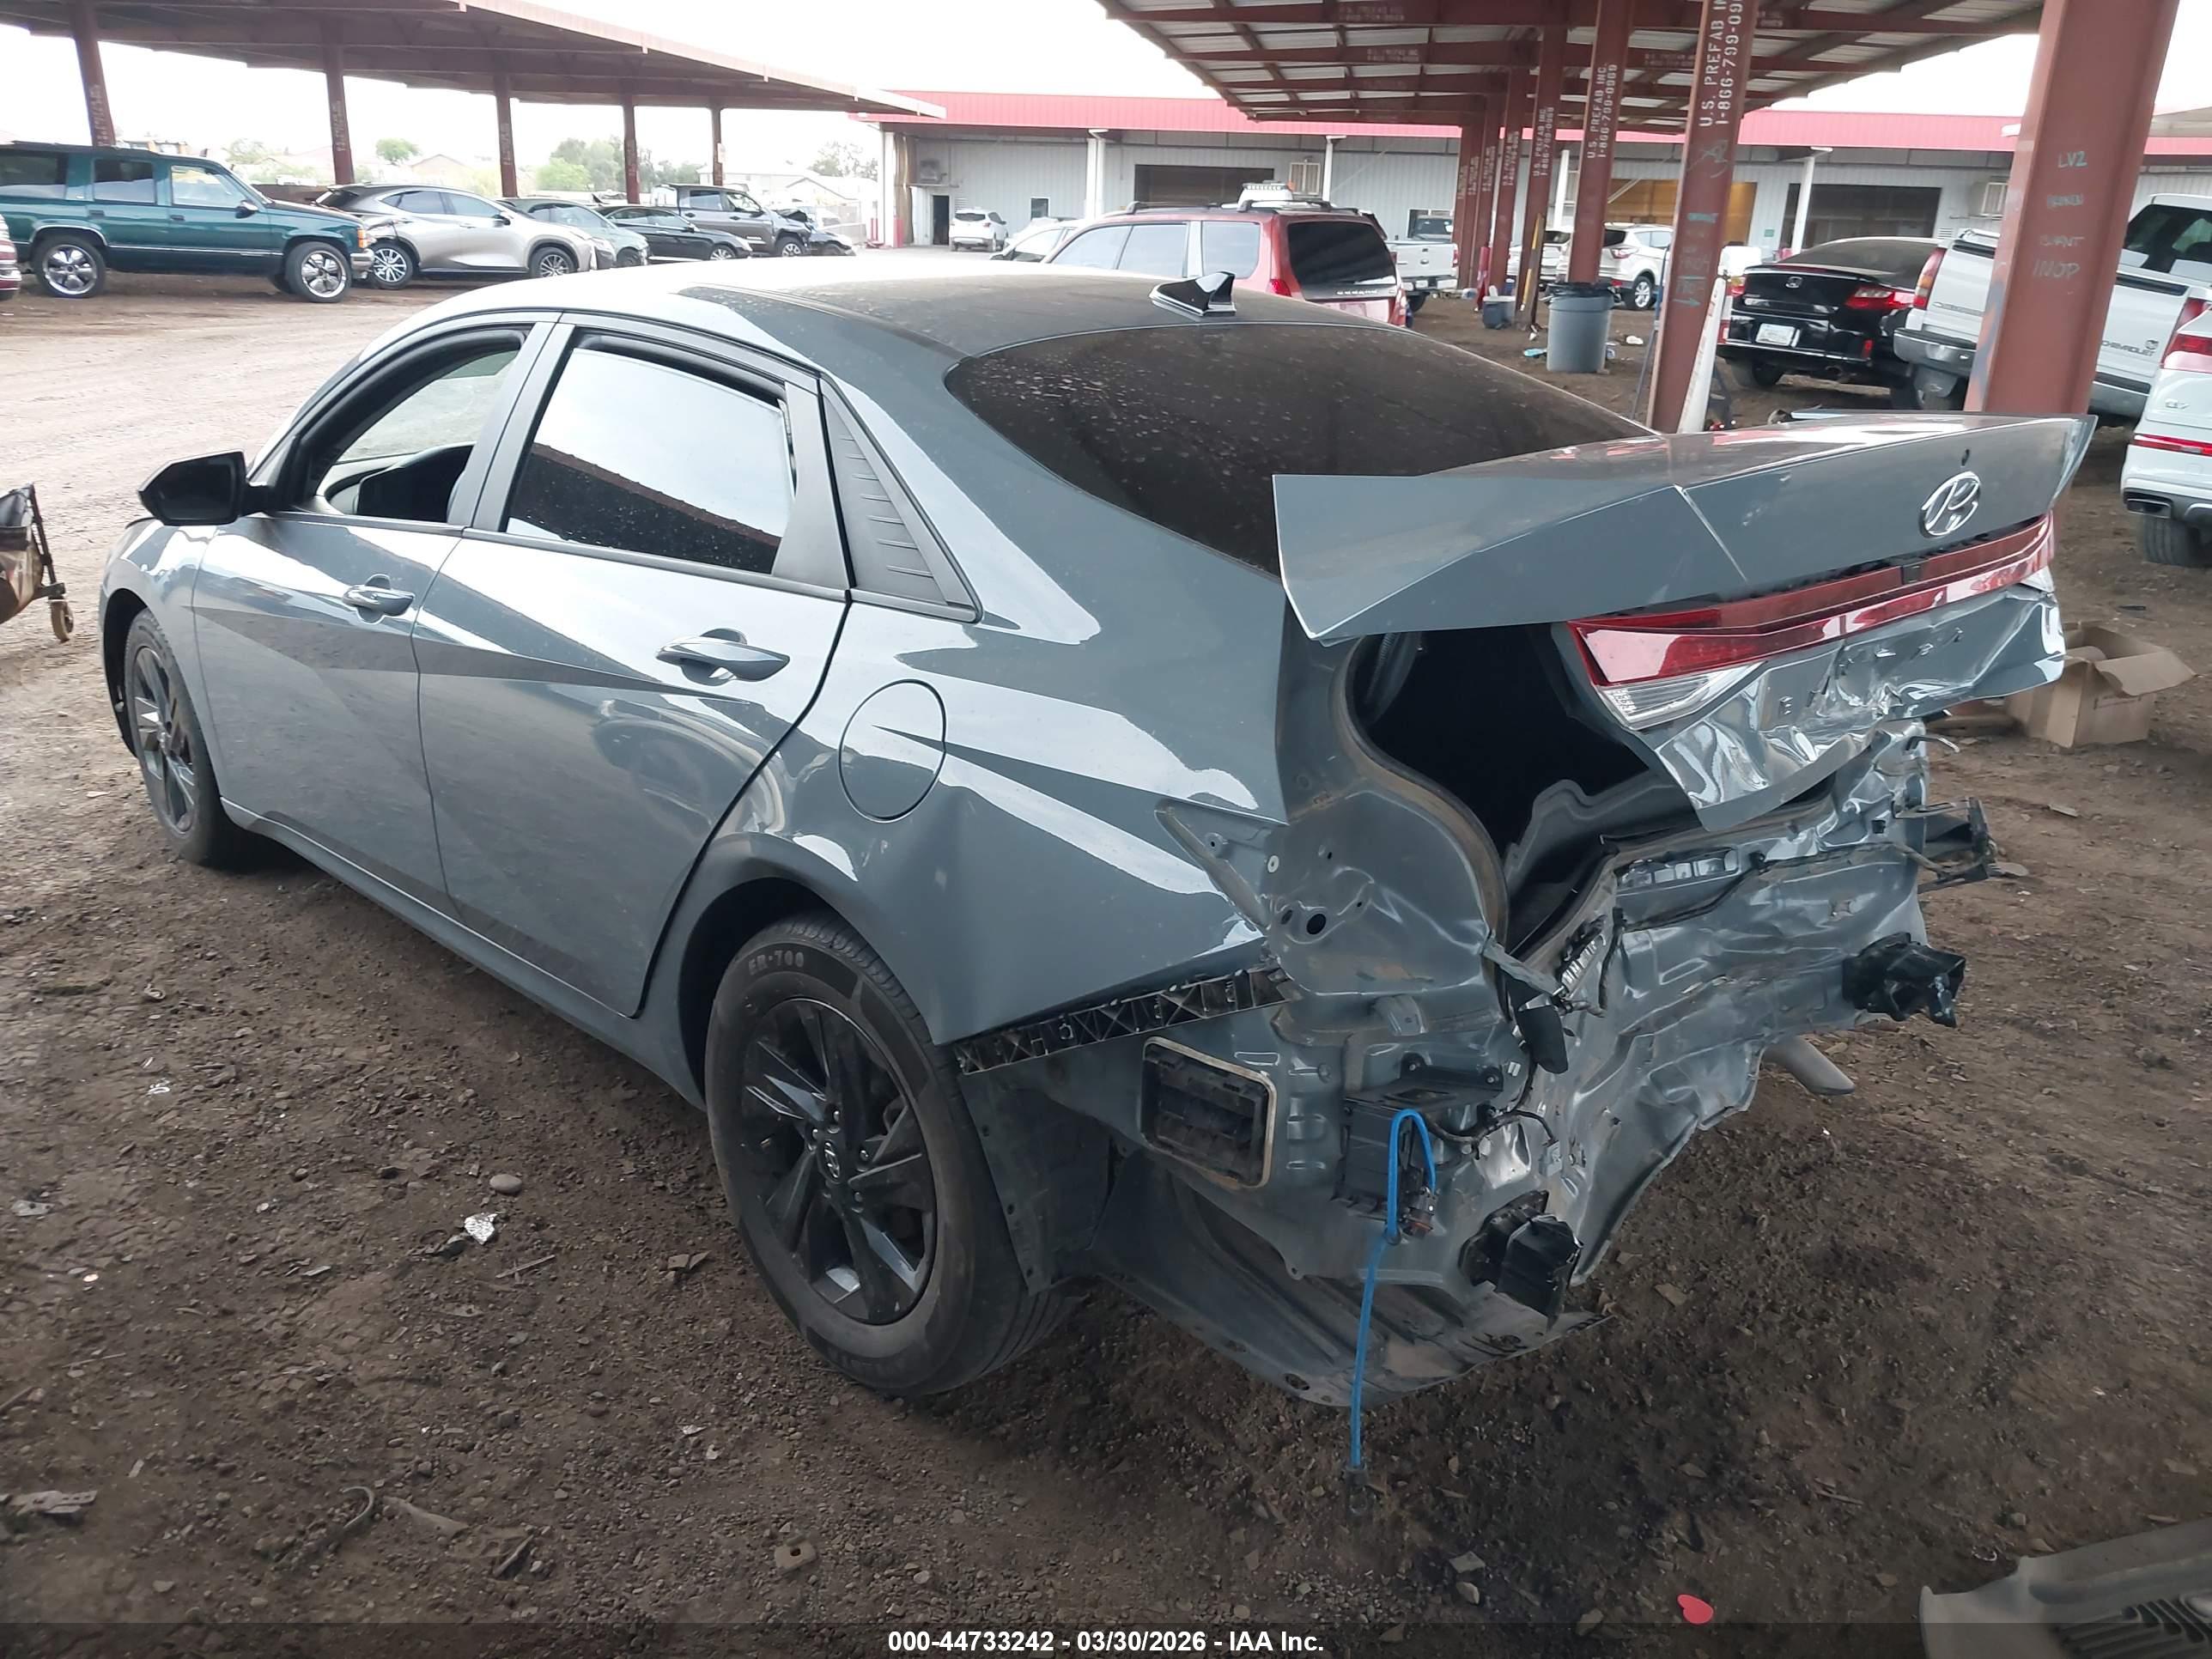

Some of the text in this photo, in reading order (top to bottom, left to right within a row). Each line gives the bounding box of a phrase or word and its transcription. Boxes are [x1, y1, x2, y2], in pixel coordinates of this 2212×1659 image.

[1704, 20, 1725, 85] PREFAB
[1715, 0, 1743, 125] 1-866-799-09
[1590, 89, 1605, 132] PREFAB
[1698, 95, 1717, 127] U.S.
